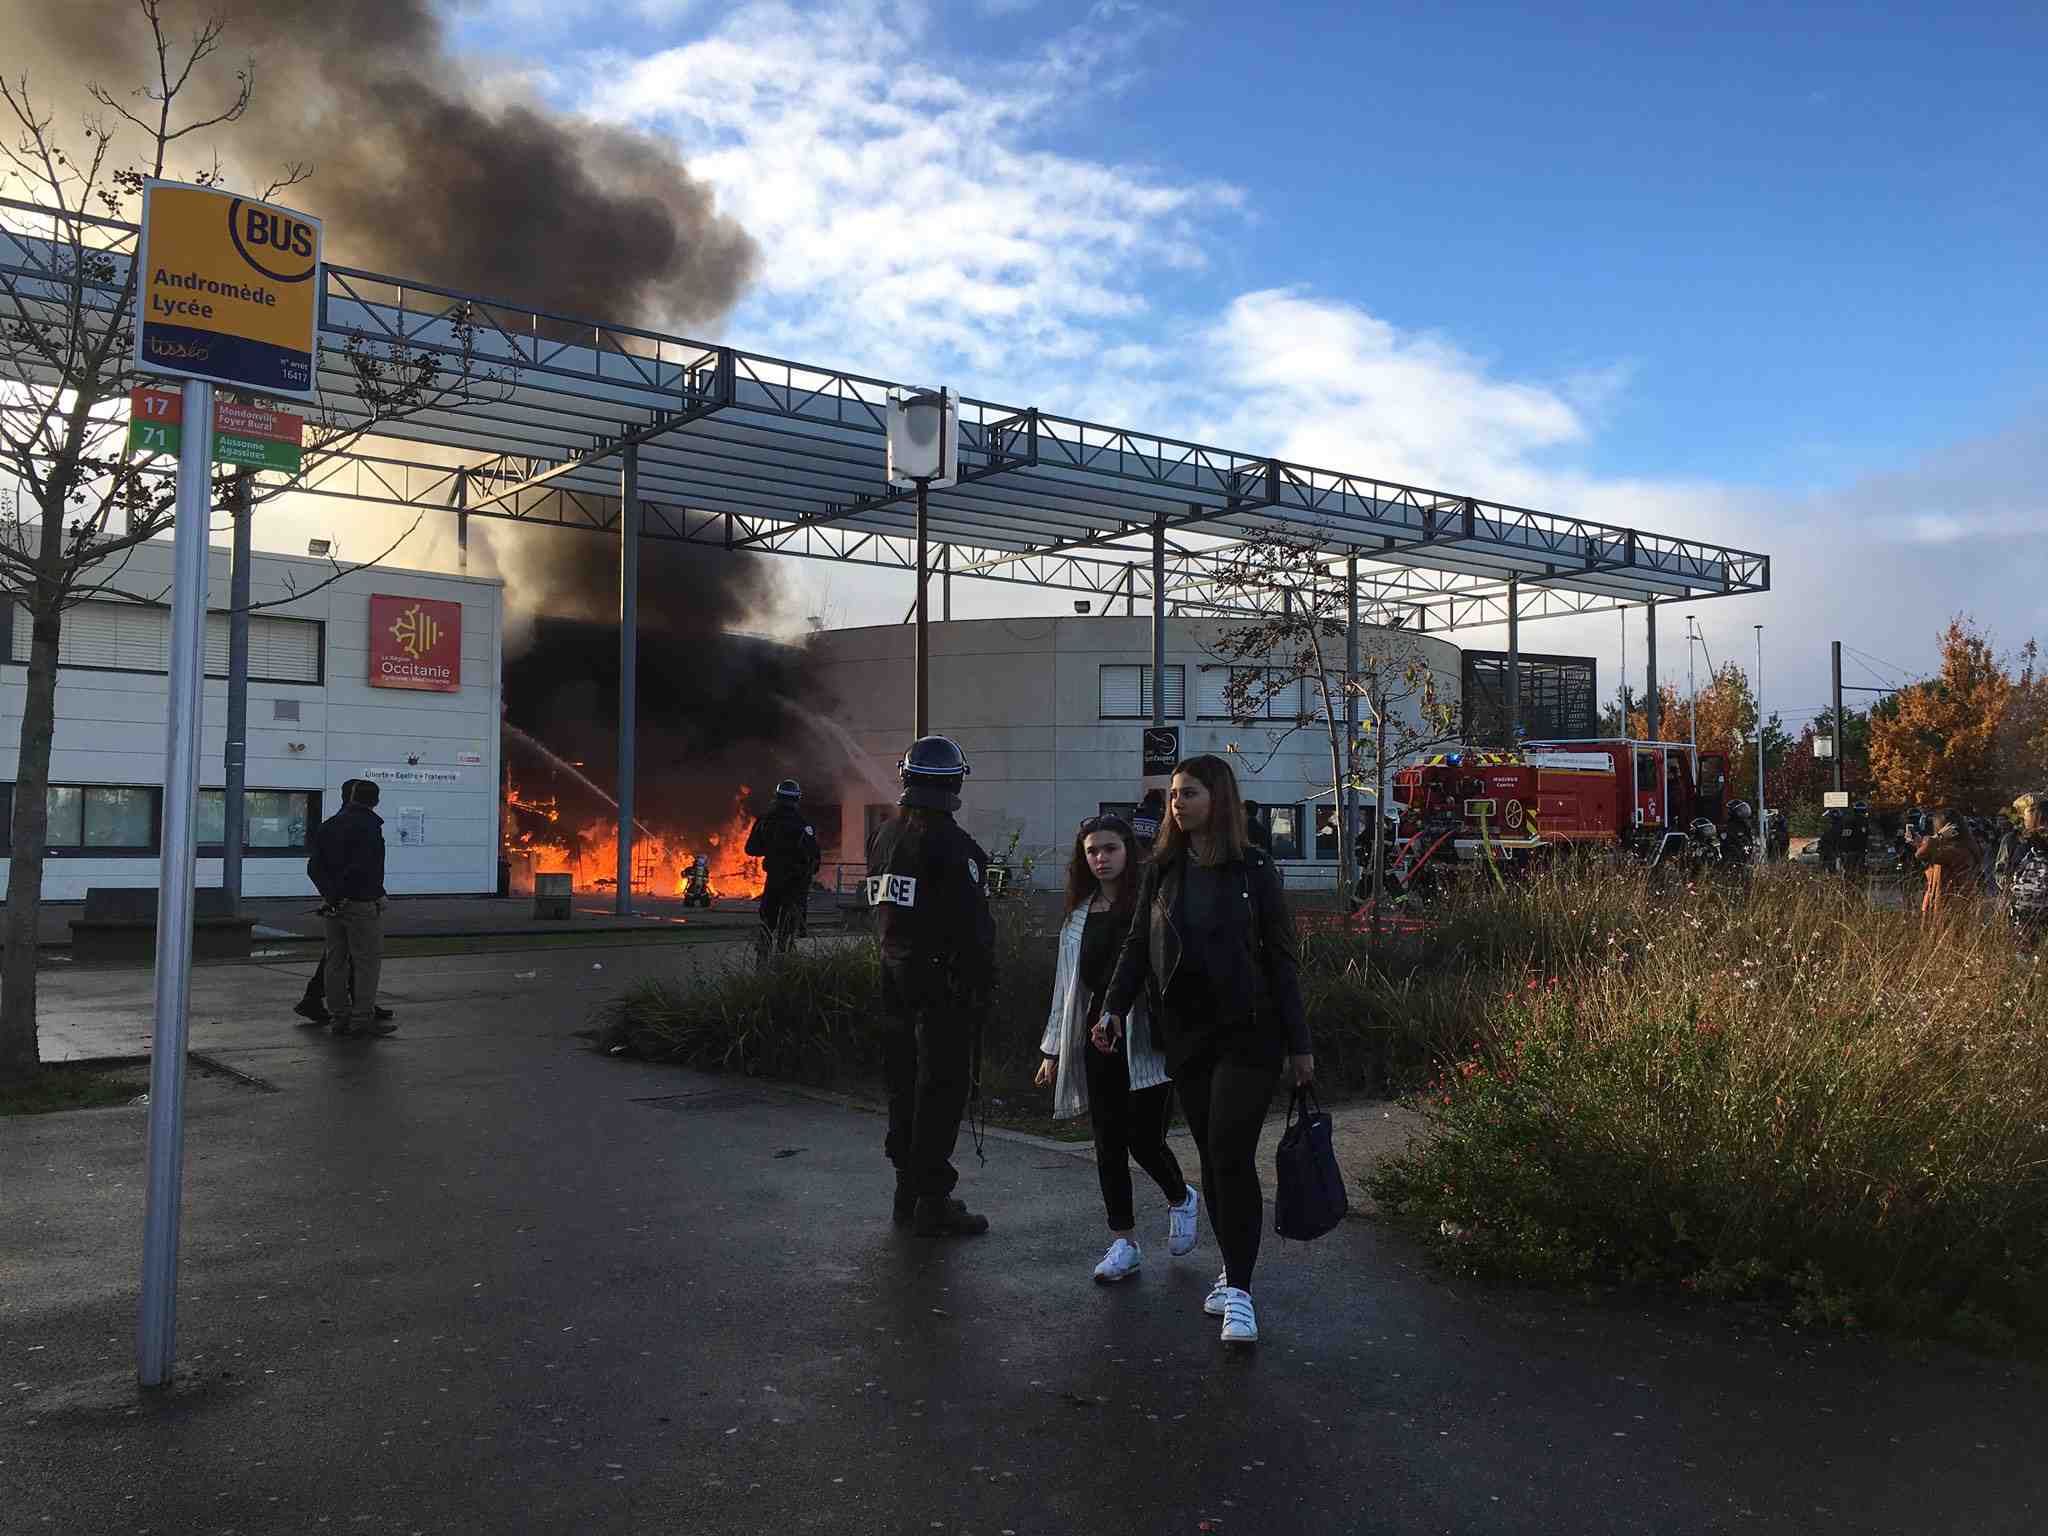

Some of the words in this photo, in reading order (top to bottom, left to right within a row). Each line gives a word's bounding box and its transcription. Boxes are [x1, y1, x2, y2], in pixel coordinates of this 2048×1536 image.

[246, 208, 312, 258] BUS
[153, 267, 276, 307] Andromède
[152, 293, 214, 319] Lycée
[145, 398, 169, 417] 17
[219, 415, 244, 427] Foyer
[143, 426, 166, 447] 71
[381, 661, 450, 678] Occitanie
[870, 877, 913, 902] PICE
